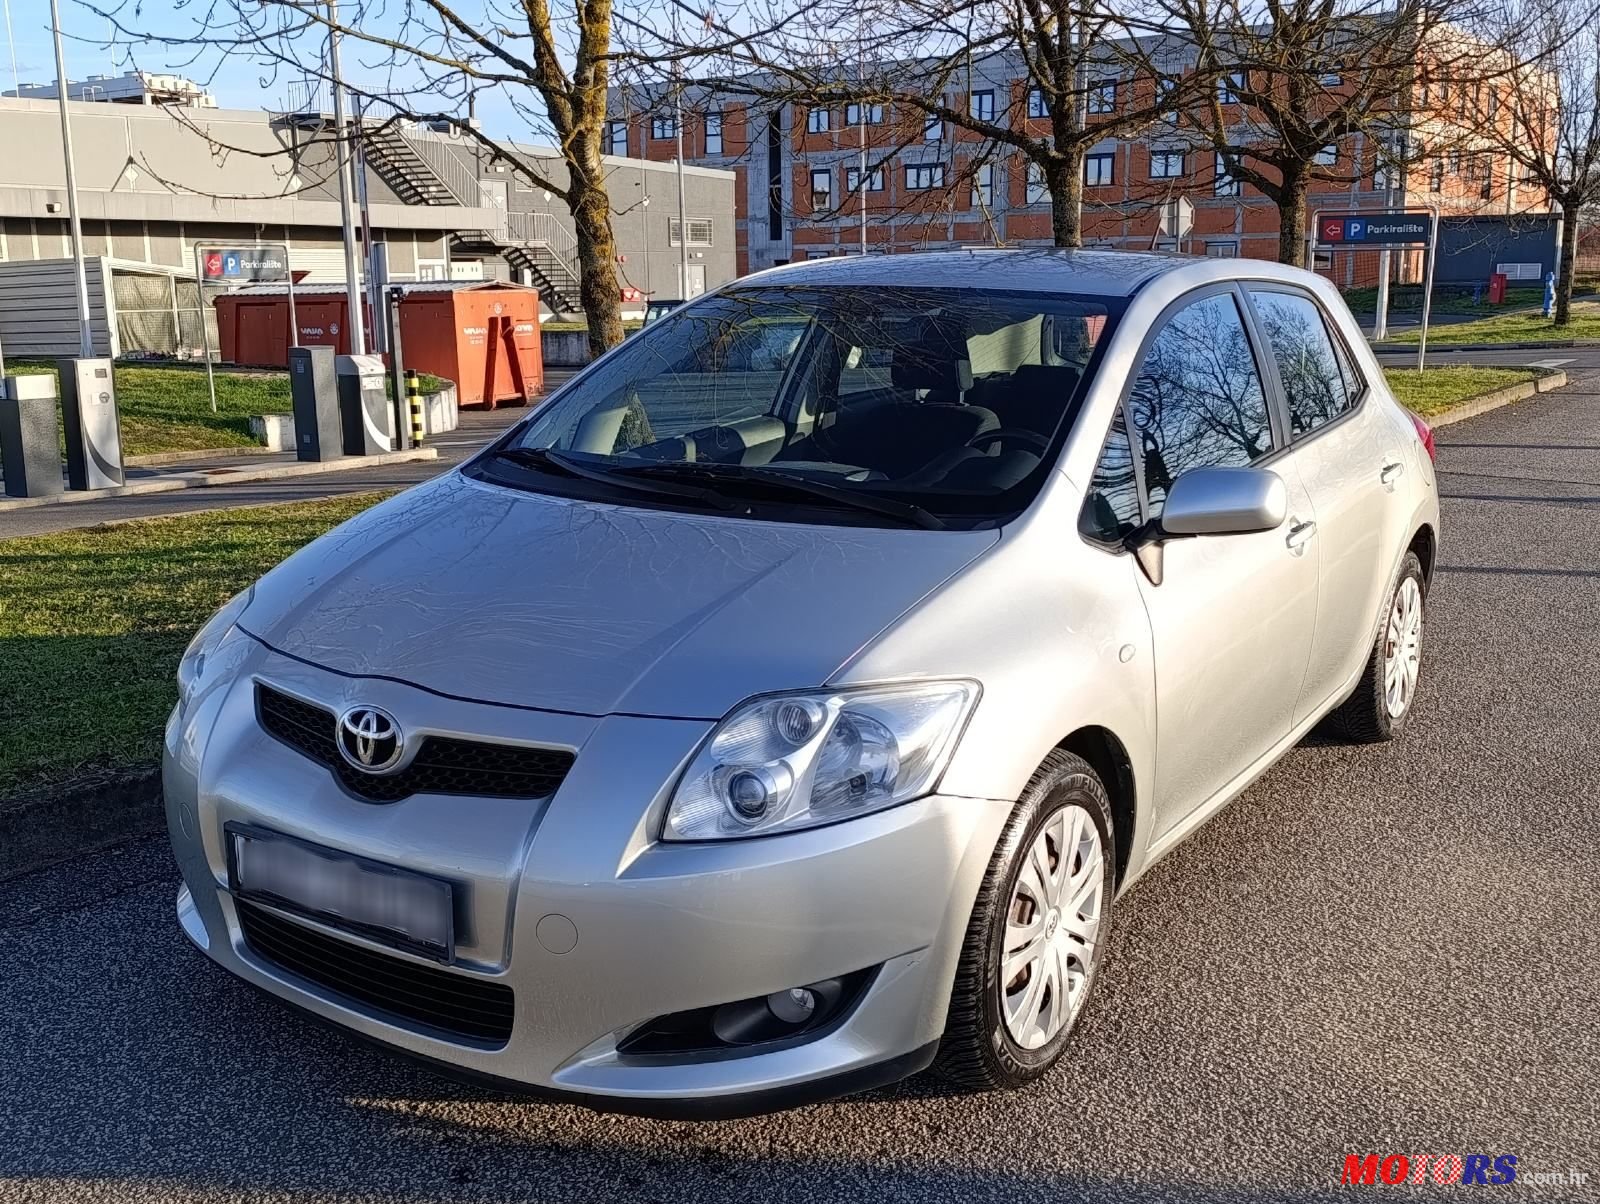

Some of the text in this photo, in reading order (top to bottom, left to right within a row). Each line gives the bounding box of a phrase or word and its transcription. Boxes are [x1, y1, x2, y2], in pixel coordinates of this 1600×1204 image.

[1350, 223, 1424, 237] P Parkiralište
[227, 257, 282, 271] P Parkiralište
